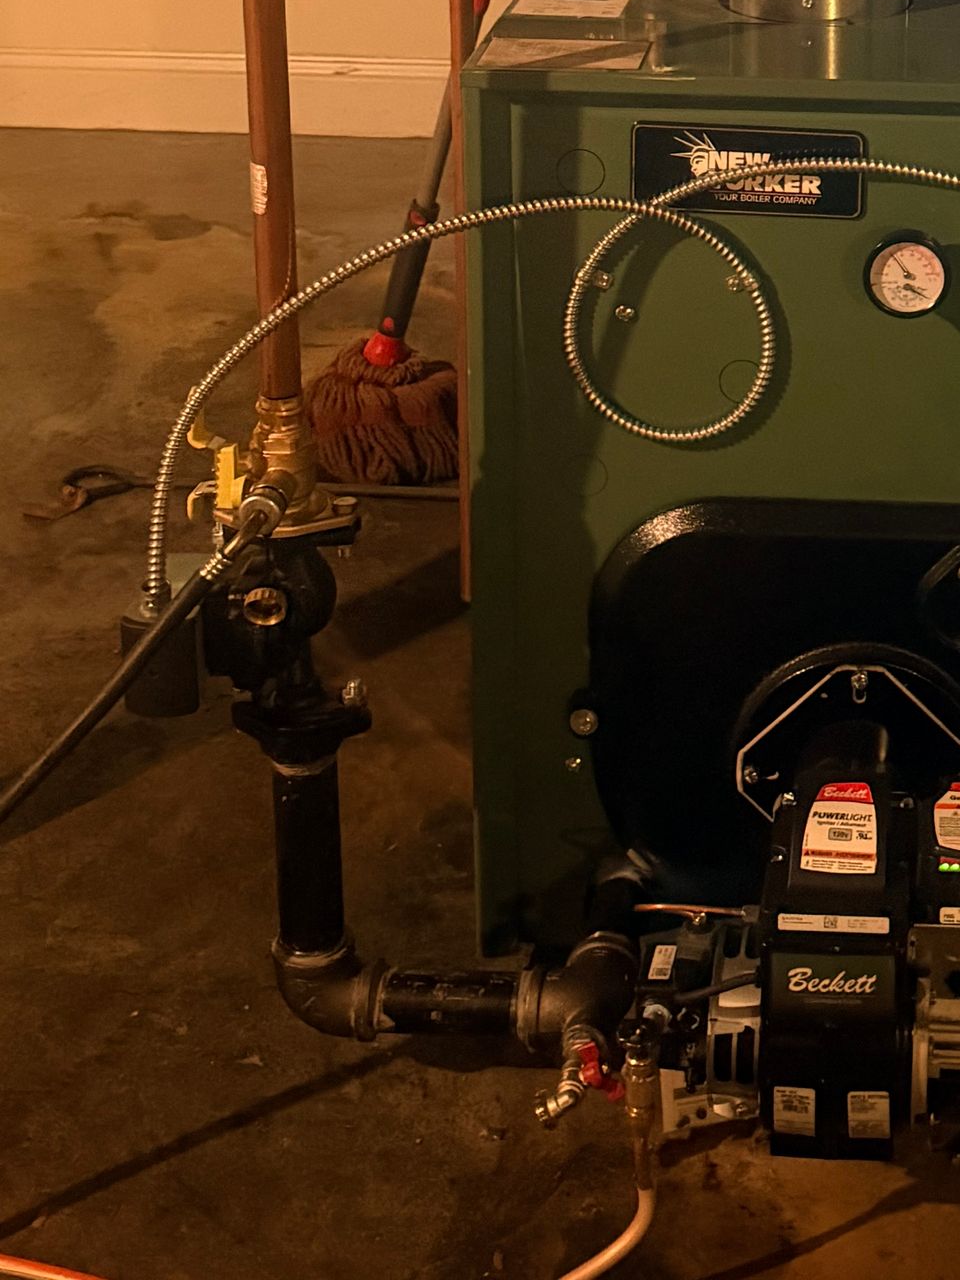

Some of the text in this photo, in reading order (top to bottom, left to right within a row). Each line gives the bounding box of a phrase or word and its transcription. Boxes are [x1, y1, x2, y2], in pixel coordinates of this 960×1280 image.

[709, 151, 771, 170] NEW
[714, 174, 822, 194] ORKER
[714, 194, 817, 205] YOUR BOILER COMPANY
[823, 786, 868, 798] Beckett
[812, 811, 873, 822] POWERLIGHT
[787, 967, 877, 993] Beckett
